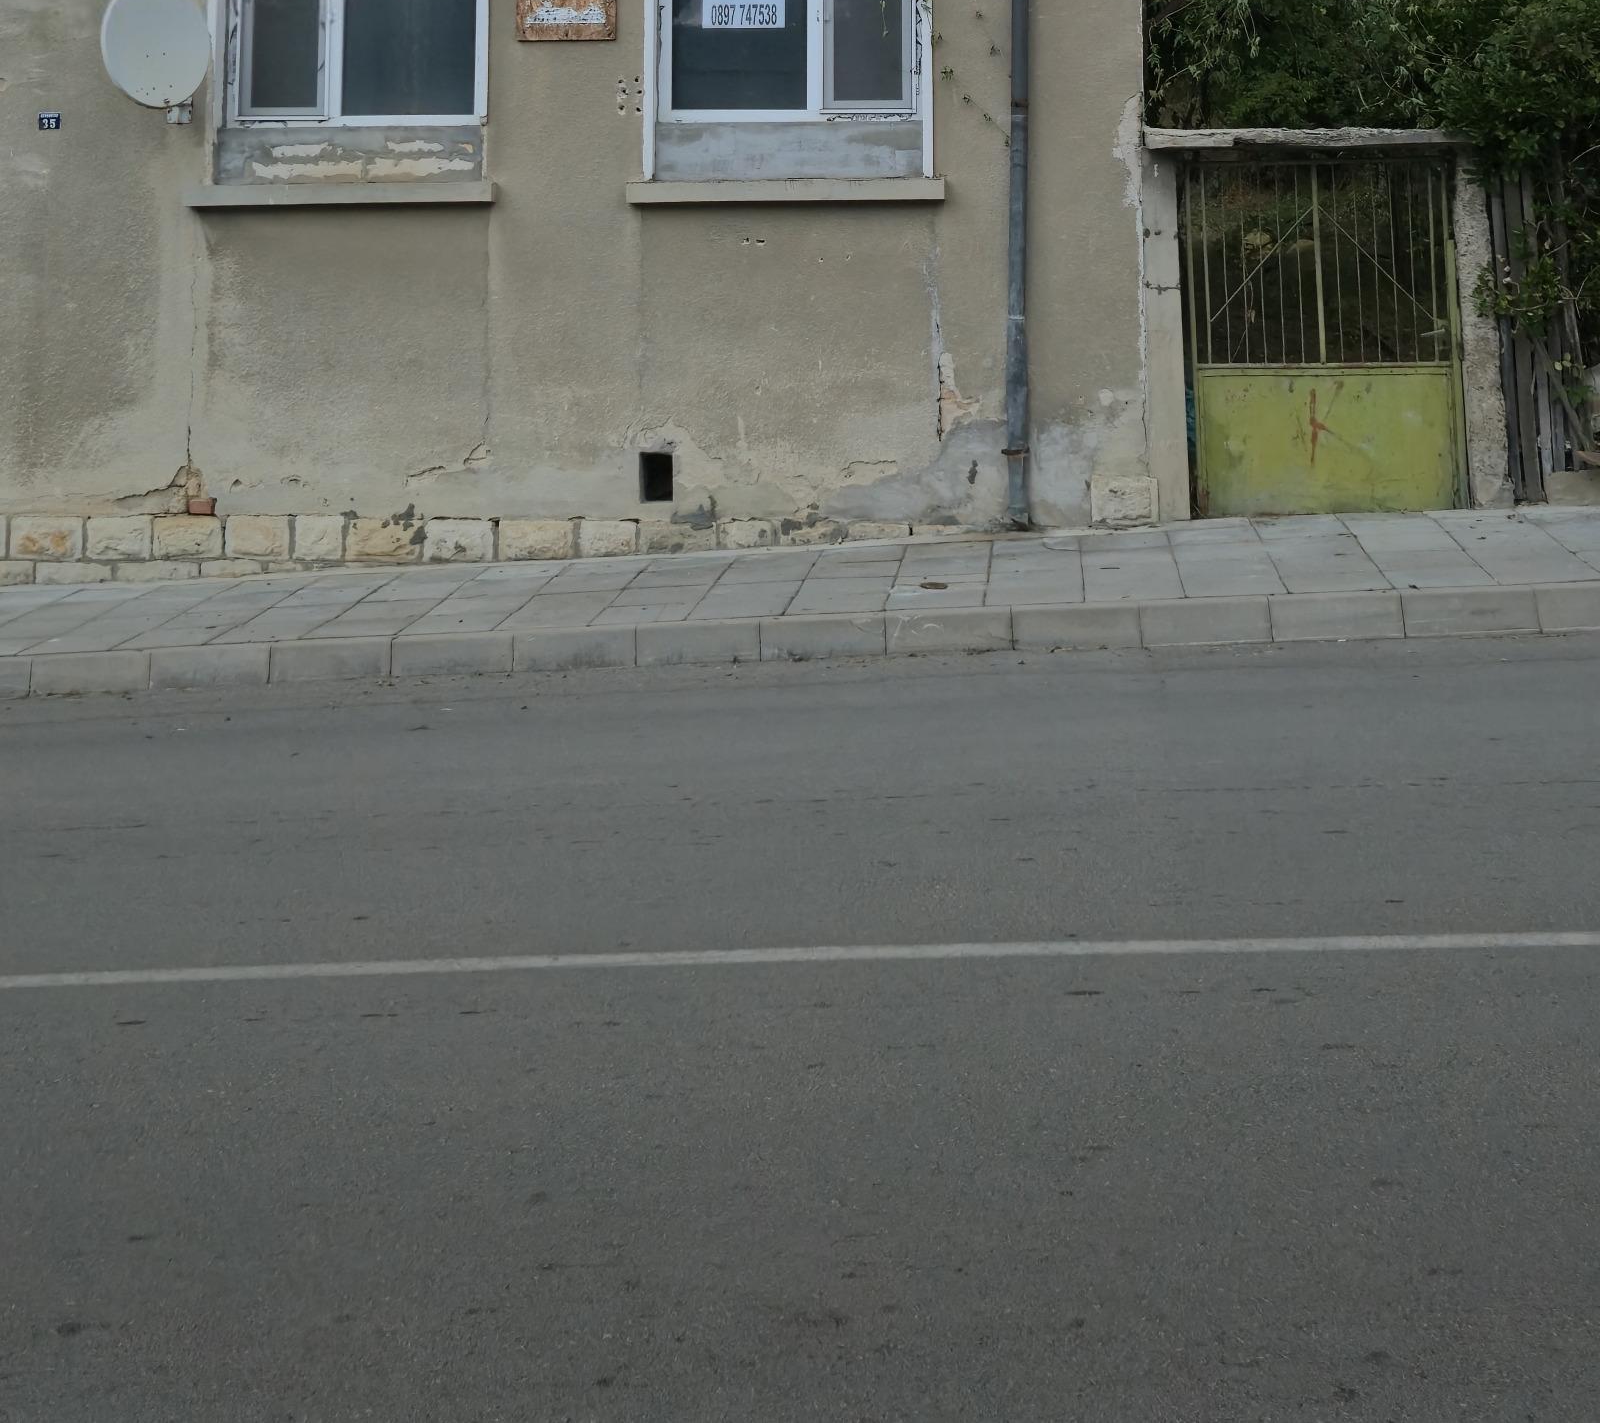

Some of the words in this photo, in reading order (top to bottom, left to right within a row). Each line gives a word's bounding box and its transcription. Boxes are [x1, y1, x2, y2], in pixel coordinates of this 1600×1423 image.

[711, 4, 736, 26] 0897
[739, 3, 778, 26] 747538
[42, 118, 57, 129] 35
